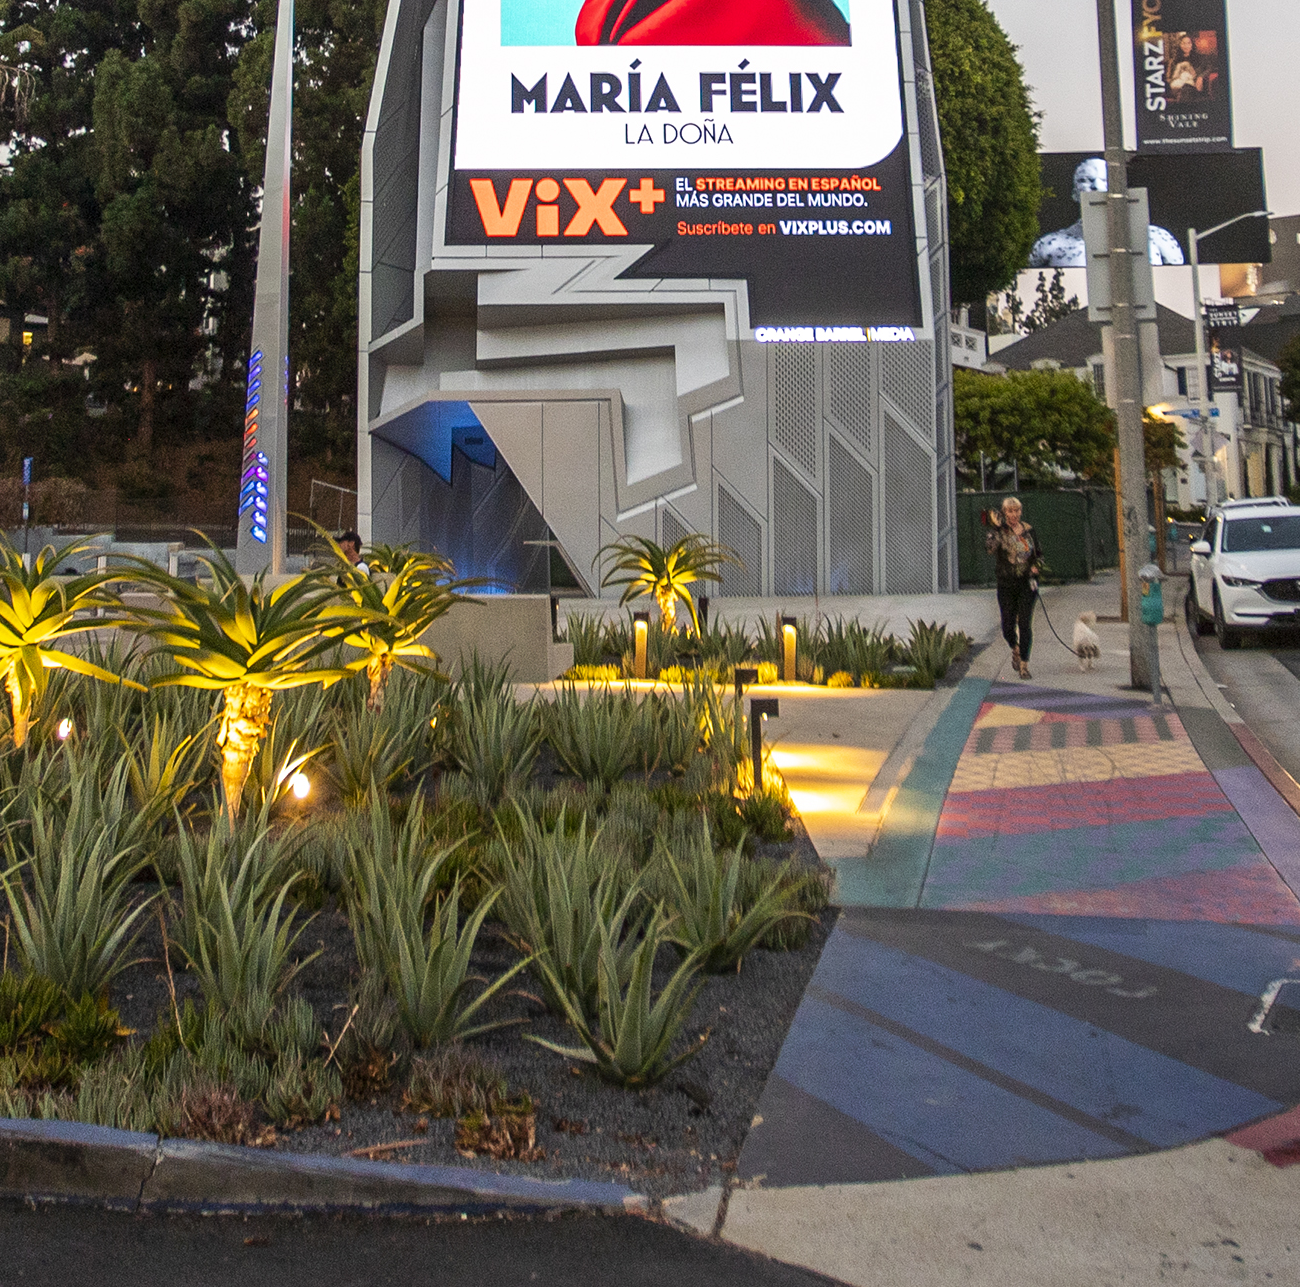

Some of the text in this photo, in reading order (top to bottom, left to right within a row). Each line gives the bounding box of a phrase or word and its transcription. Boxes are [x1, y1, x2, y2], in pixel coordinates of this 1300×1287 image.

[1144, 39, 1167, 111] STARZ
[510, 58, 844, 114] MARÍA FÉLIX
[625, 118, 734, 144] LA DOÑA
[675, 174, 882, 191] EL STREAMING EN ESPAÑOL
[675, 191, 868, 207] MÁS GRANDE DEL MUNDO.
[677, 220, 892, 236] Suscríbete en VIXPLUS.COM
[869, 326, 916, 342] MEDIA
